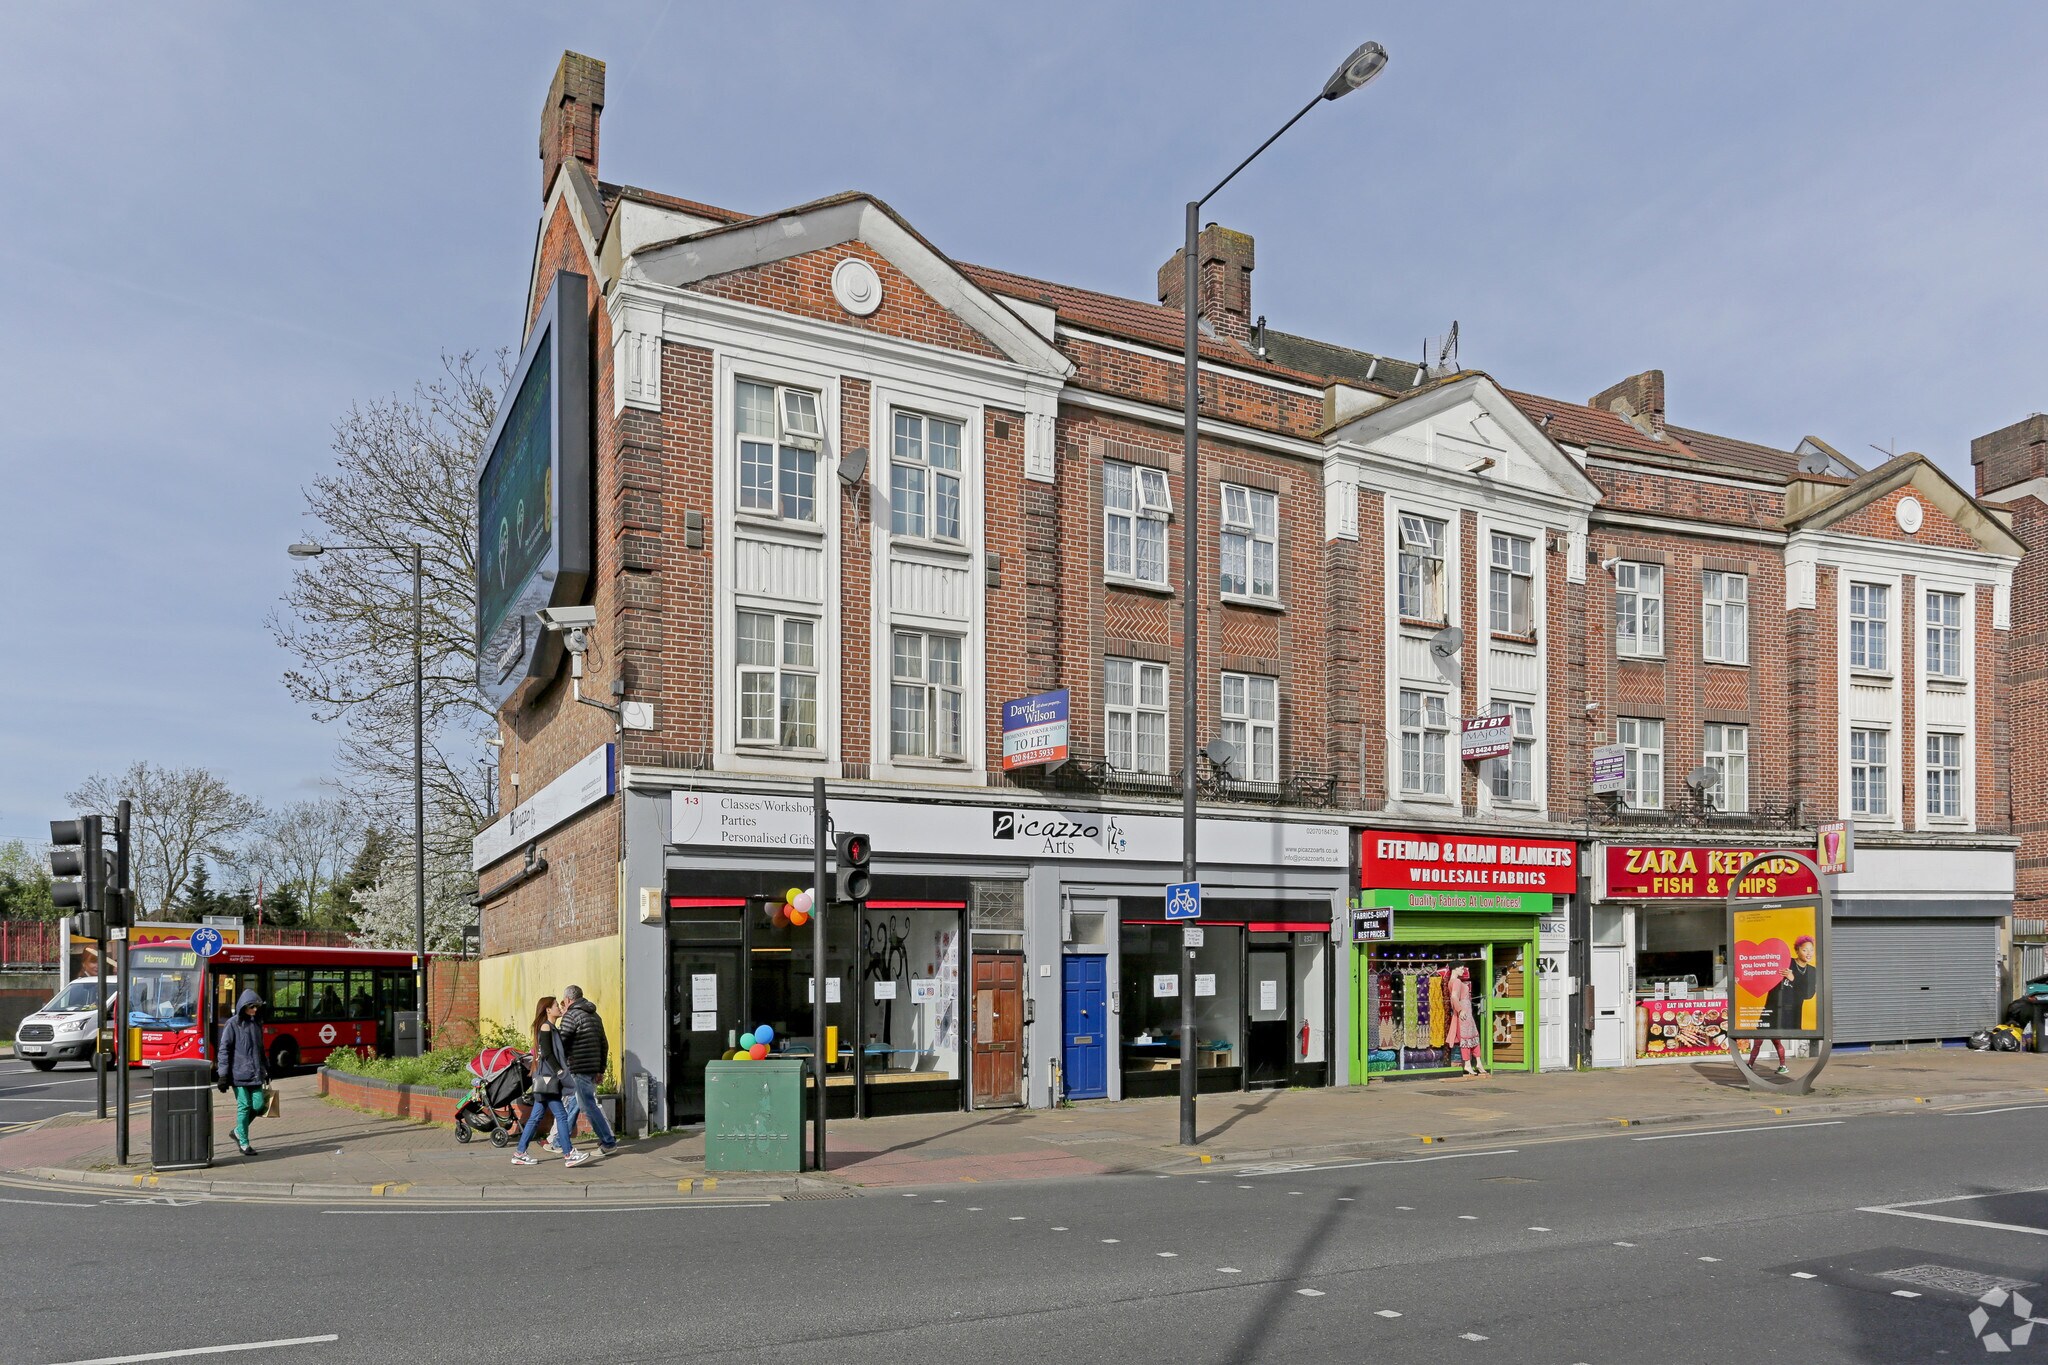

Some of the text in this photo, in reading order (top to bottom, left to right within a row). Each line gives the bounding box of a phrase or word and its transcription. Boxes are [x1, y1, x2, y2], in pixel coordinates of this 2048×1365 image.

[1010, 700, 1035, 717] David
[1025, 710, 1056, 723] Wilson
[1029, 727, 1048, 736] CORNER
[1049, 724, 1065, 732] SHOPS
[1467, 717, 1506, 730] LET BY
[1014, 735, 1050, 751] TO LET
[1475, 745, 1491, 754] 8424
[1011, 754, 1021, 763] 020
[1022, 751, 1037, 761] 8423
[1039, 748, 1054, 758] 5933
[685, 797, 699, 805] 1-3
[721, 815, 757, 826] Parties
[993, 811, 1099, 839] Picazzo
[1820, 823, 1844, 832] KEBABS
[721, 831, 815, 845] Personalised Gifts
[1042, 837, 1075, 854] Arts
[1377, 839, 1572, 867] ETEMAD & KHAN BLANKETS
[1626, 849, 1800, 875] ZARA KEBABS
[1821, 864, 1843, 872] OPEN
[1410, 868, 1546, 885] WHOLESALE FABRICS
[1653, 877, 1693, 894] FISH
[1707, 877, 1719, 894] &
[1409, 893, 1521, 908] Quality Fabrics At Low Prices!
[1364, 921, 1380, 929] RETAIL
[1357, 930, 1386, 939] BEST PRICES
[143, 953, 197, 966] Harrow H10
[1749, 953, 1781, 961] something
